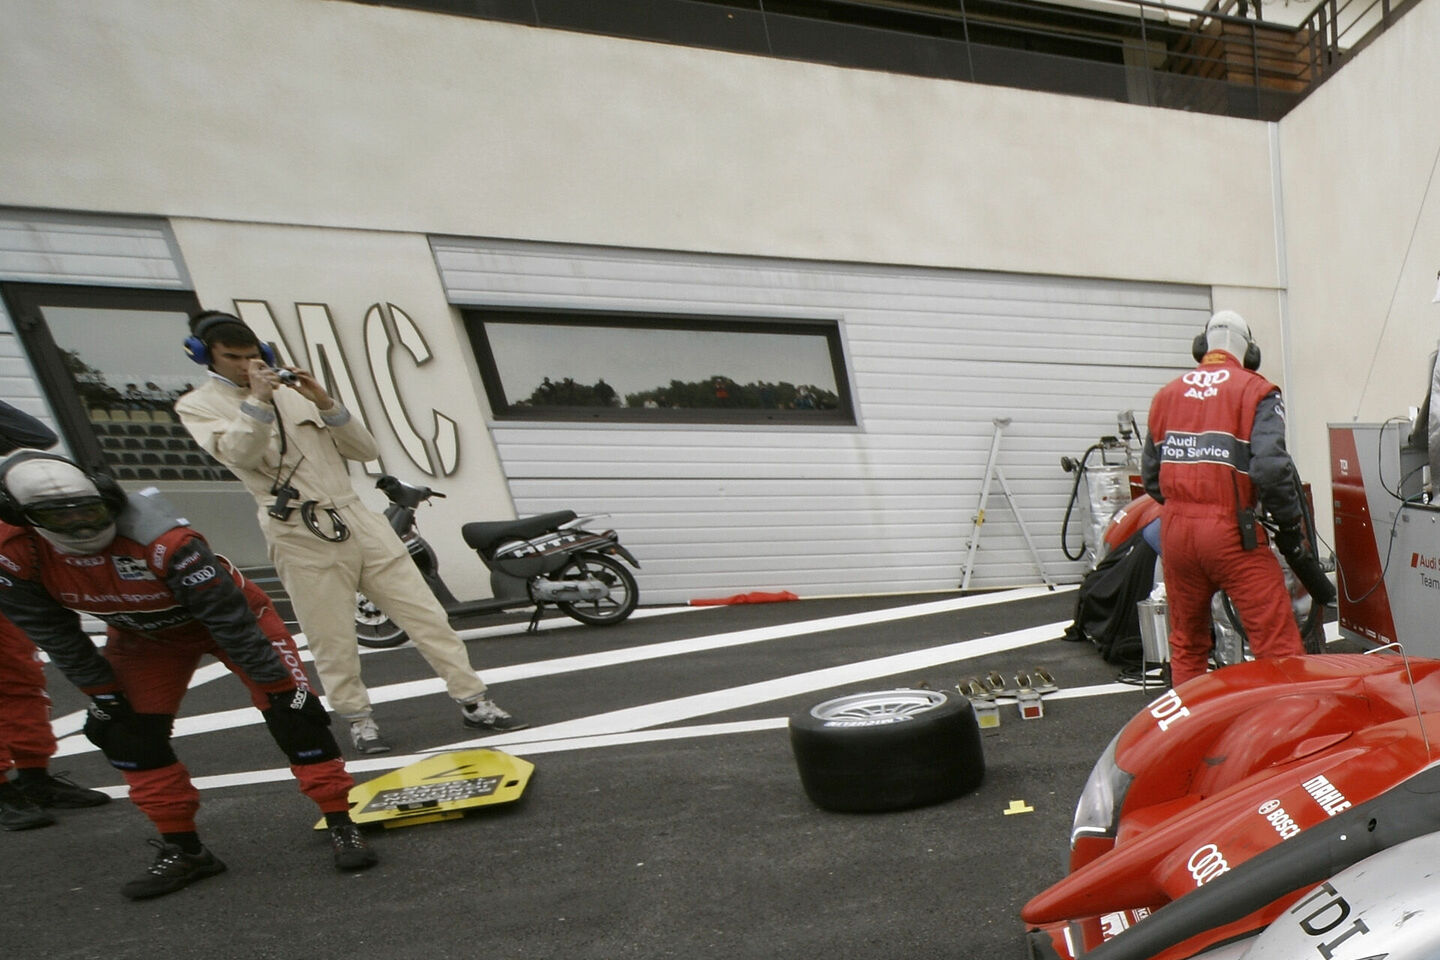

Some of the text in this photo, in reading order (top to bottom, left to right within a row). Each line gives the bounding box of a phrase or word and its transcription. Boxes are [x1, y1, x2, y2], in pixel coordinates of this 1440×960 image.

[1184, 386, 1219, 400] Audi
[1166, 436, 1197, 447] Audi
[1161, 446, 1230, 459] Top Service
[1420, 555, 1437, 569] Audi
[1420, 573, 1440, 589] Team
[1147, 689, 1191, 732] TDI
[1302, 775, 1352, 816] MAHLE
[1291, 882, 1370, 960] TDI
